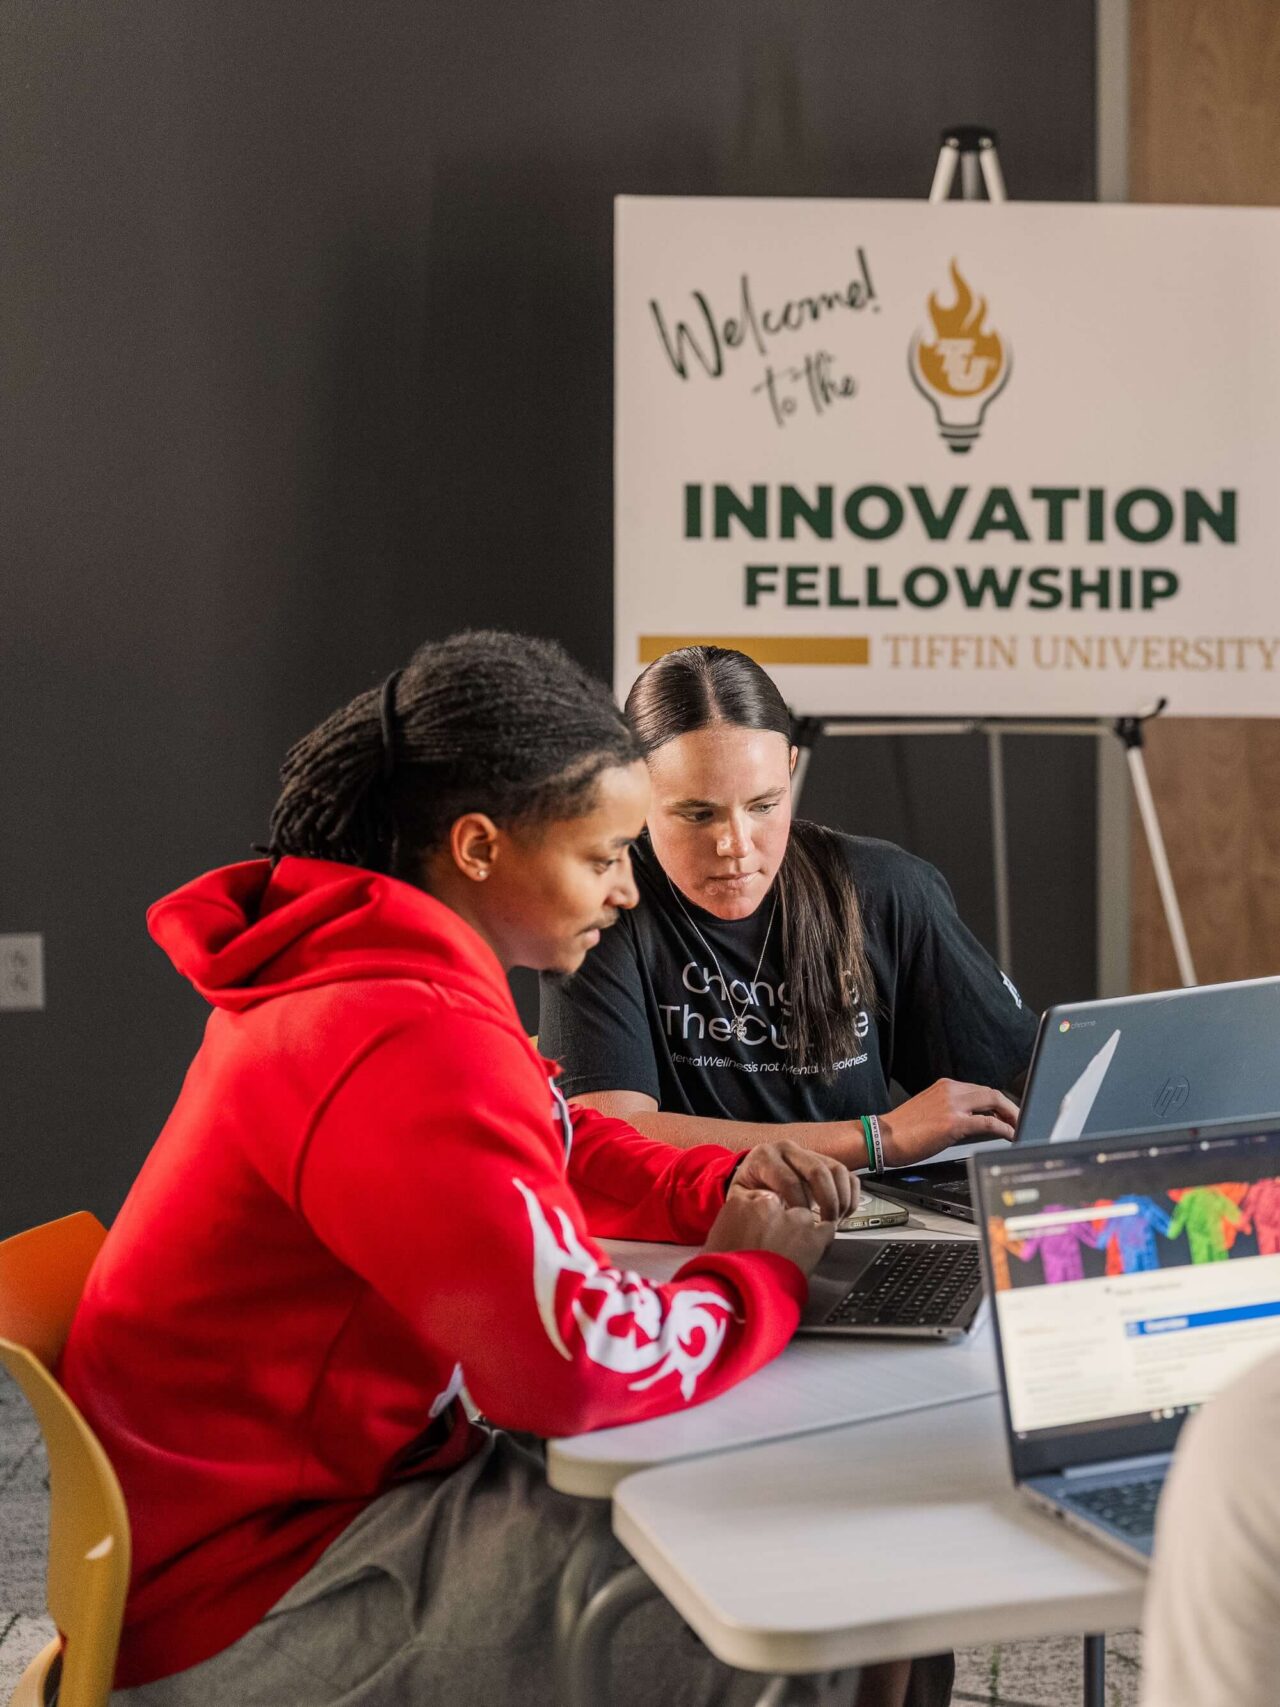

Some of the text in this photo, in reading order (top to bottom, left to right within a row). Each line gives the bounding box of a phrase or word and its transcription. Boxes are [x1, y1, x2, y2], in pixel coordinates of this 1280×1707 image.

[648, 245, 880, 382] Welcome!
[752, 350, 857, 428] to the
[683, 483, 1238, 545] INNOVATION
[744, 565, 1180, 611] FELLOWSHIP
[882, 634, 1018, 670] TIFFIN
[659, 1003, 732, 1042] The
[760, 1062, 780, 1072] not
